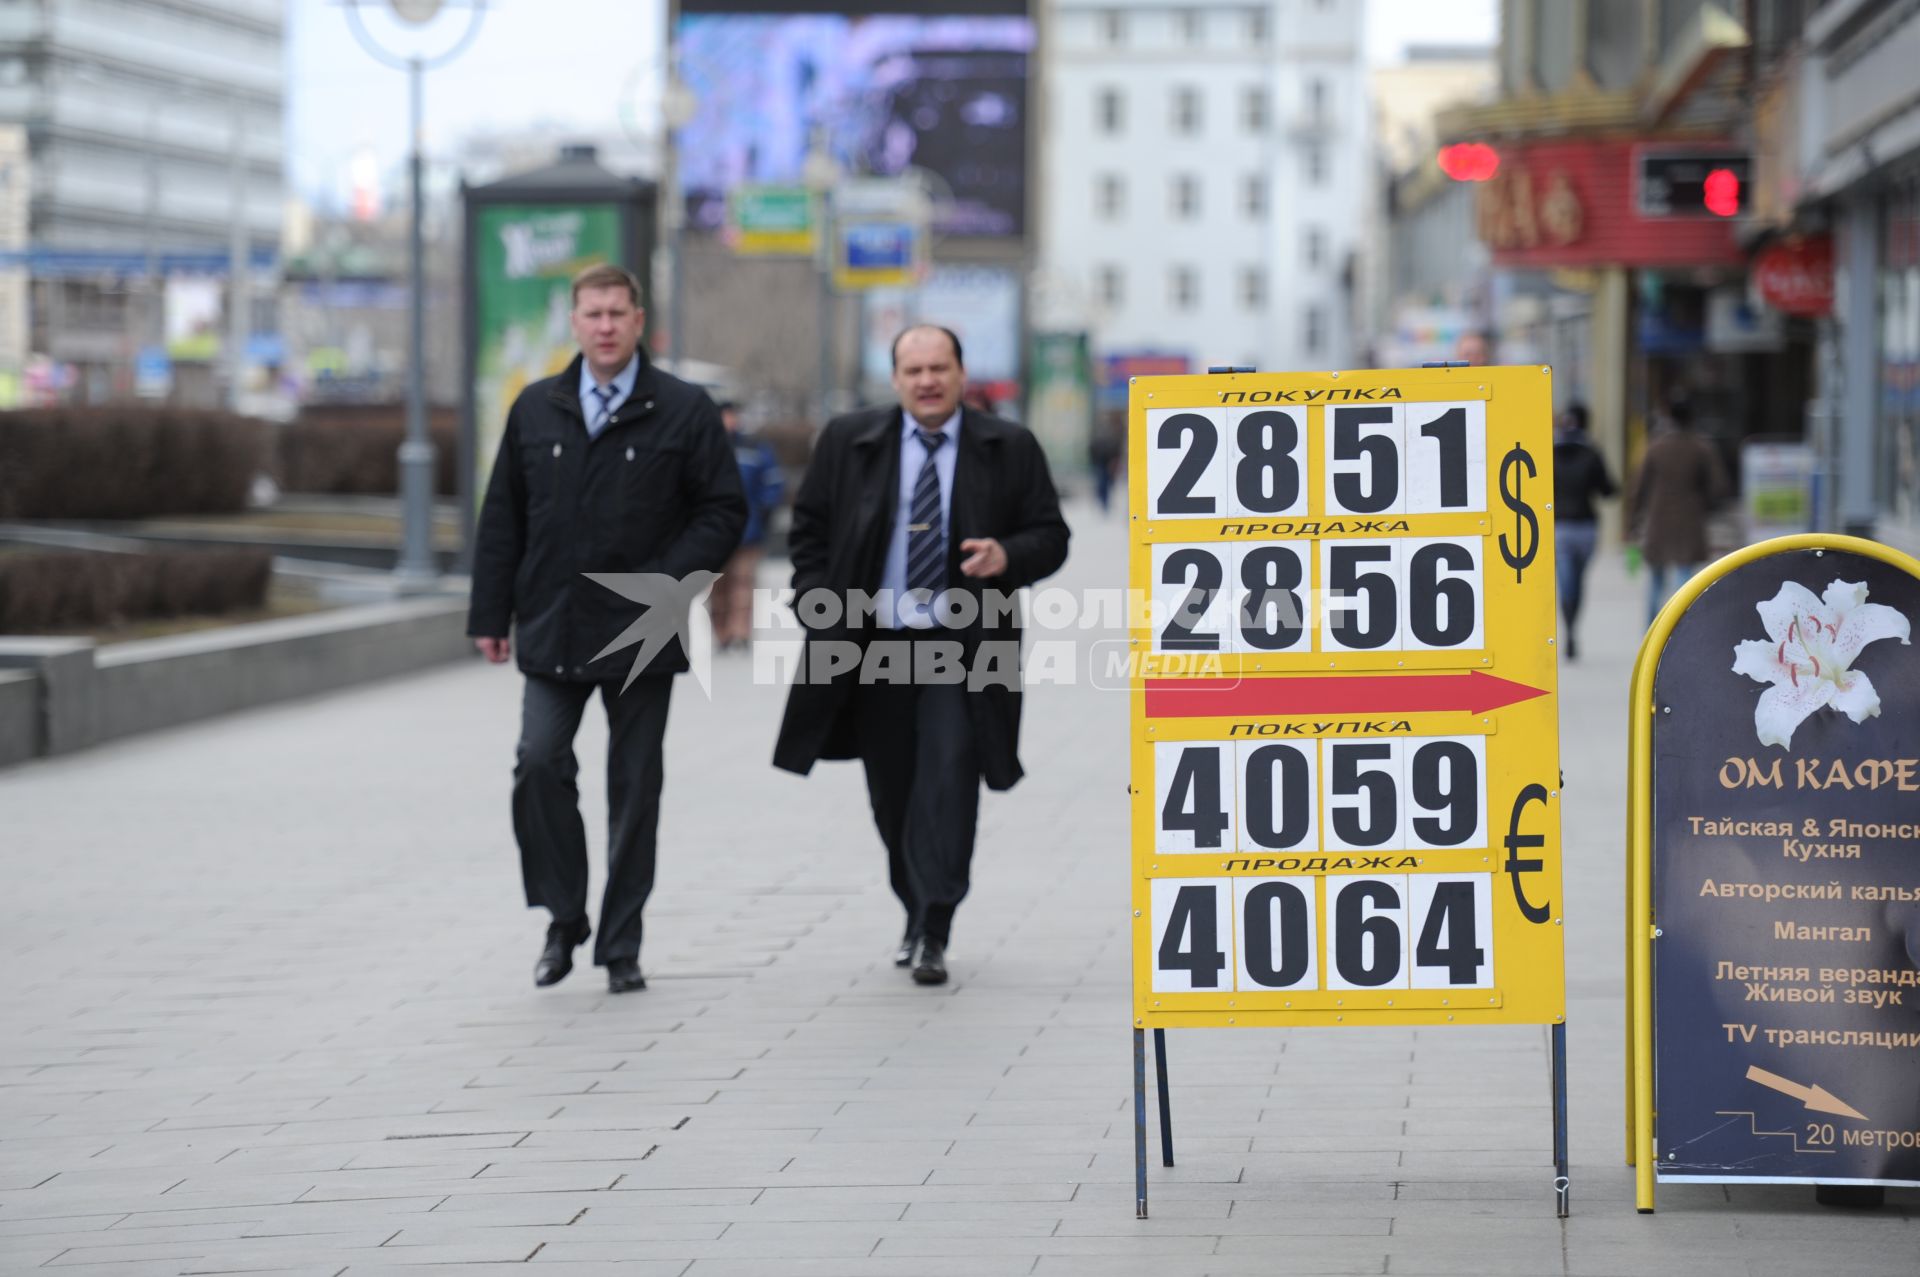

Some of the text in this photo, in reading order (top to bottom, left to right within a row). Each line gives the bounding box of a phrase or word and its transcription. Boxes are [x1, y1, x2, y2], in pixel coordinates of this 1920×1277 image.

[1220, 387, 1403, 404] ПОКУПКА
[1219, 520, 1411, 537] ПРОДАЖА
[1229, 720, 1413, 737] ПОКУПКА
[1719, 757, 1920, 791] ОМ КАФЕ
[1688, 816, 1793, 837] Тайская
[1801, 818, 1820, 837] &
[1783, 839, 1861, 861] Кухня
[1225, 857, 1419, 872] ПРОДАЖА
[1700, 879, 1842, 902] Авторский
[1774, 921, 1871, 942] Мангал
[1716, 961, 1810, 981] Летняя
[1745, 982, 1902, 1009] Живой звук
[1722, 1024, 1920, 1049] TV трансляции
[1806, 1124, 1835, 1145] 20
